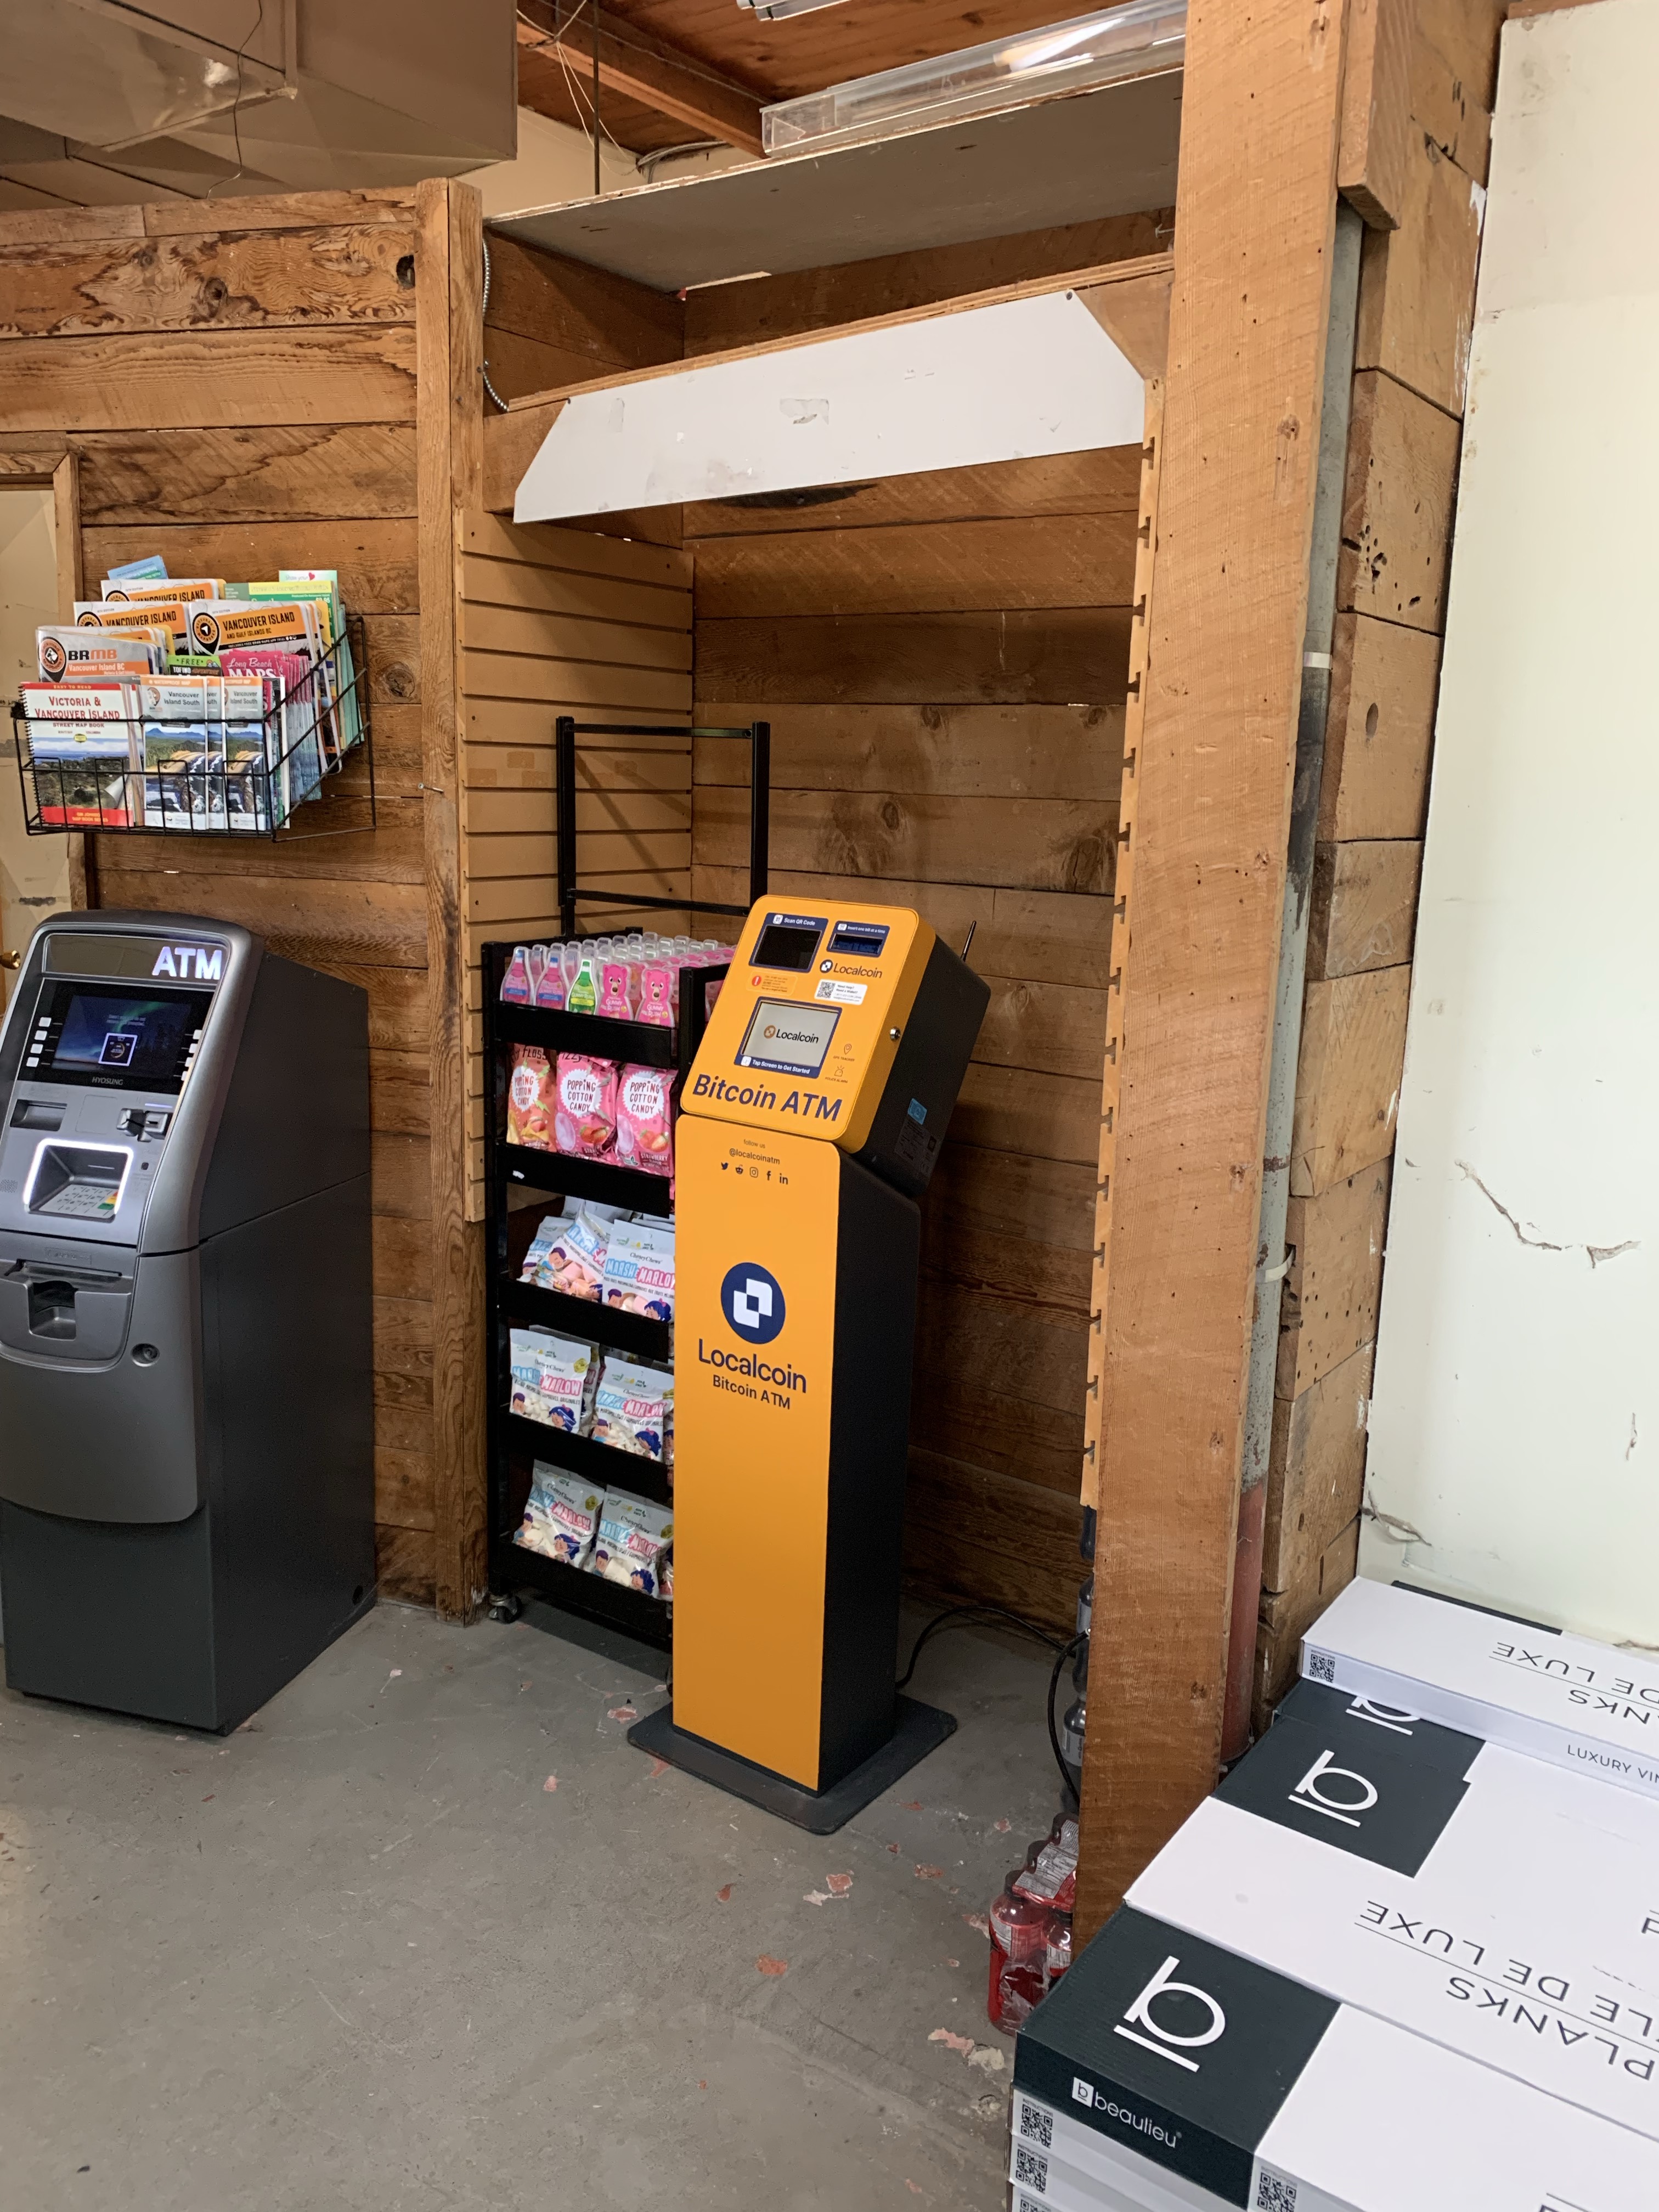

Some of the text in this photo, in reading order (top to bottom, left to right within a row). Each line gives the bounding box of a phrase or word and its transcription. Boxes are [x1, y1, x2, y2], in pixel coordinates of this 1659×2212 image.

[179, 590, 205, 602] ISLAND
[106, 614, 149, 627] VANCOUVER
[151, 611, 177, 624] ISLAND
[223, 612, 295, 631] VANCOUVER ISLAND
[68, 649, 117, 661] BRMB
[227, 658, 272, 672] Long Beach
[229, 668, 275, 678] MAPS
[48, 696, 101, 707] VICTORIA &
[35, 708, 120, 720] VANCOUVER ISLAND
[152, 946, 222, 980] ATM
[833, 963, 883, 979] Localcoin
[776, 1029, 819, 1044] Localcoin
[792, 1066, 810, 1074] Started
[92, 1076, 123, 1086] HYOSUNG
[516, 1088, 532, 1097] COTTON
[568, 1092, 593, 1102] COTTON
[630, 1093, 658, 1104] COTTON
[693, 1074, 843, 1121] Bitcoin ATM
[517, 1097, 529, 1105] CANDY
[569, 1102, 591, 1112] CANDY
[631, 1104, 655, 1114] CANDY
[743, 1139, 758, 1147] follow
[729, 1148, 780, 1165] @localcoinatm
[606, 1259, 637, 1279] MARSH
[698, 1338, 806, 1393] Localcoin
[540, 1374, 582, 1396] MARLOW
[713, 1374, 791, 1410] Bitcoin ATM
[551, 1502, 591, 1531] MARLOW
[1492, 1642, 1595, 1683] LUXE
[1568, 1745, 1632, 1774] LUXURY
[1360, 1900, 1570, 2002] DE LUXE
[1446, 1976, 1656, 2081] PLANKS
[1023, 2098, 1053, 2117] INSTRUCTIONS
[1095, 2091, 1176, 2148] beaulieu
[1018, 2143, 1048, 2163] INSTRUCTIONS
